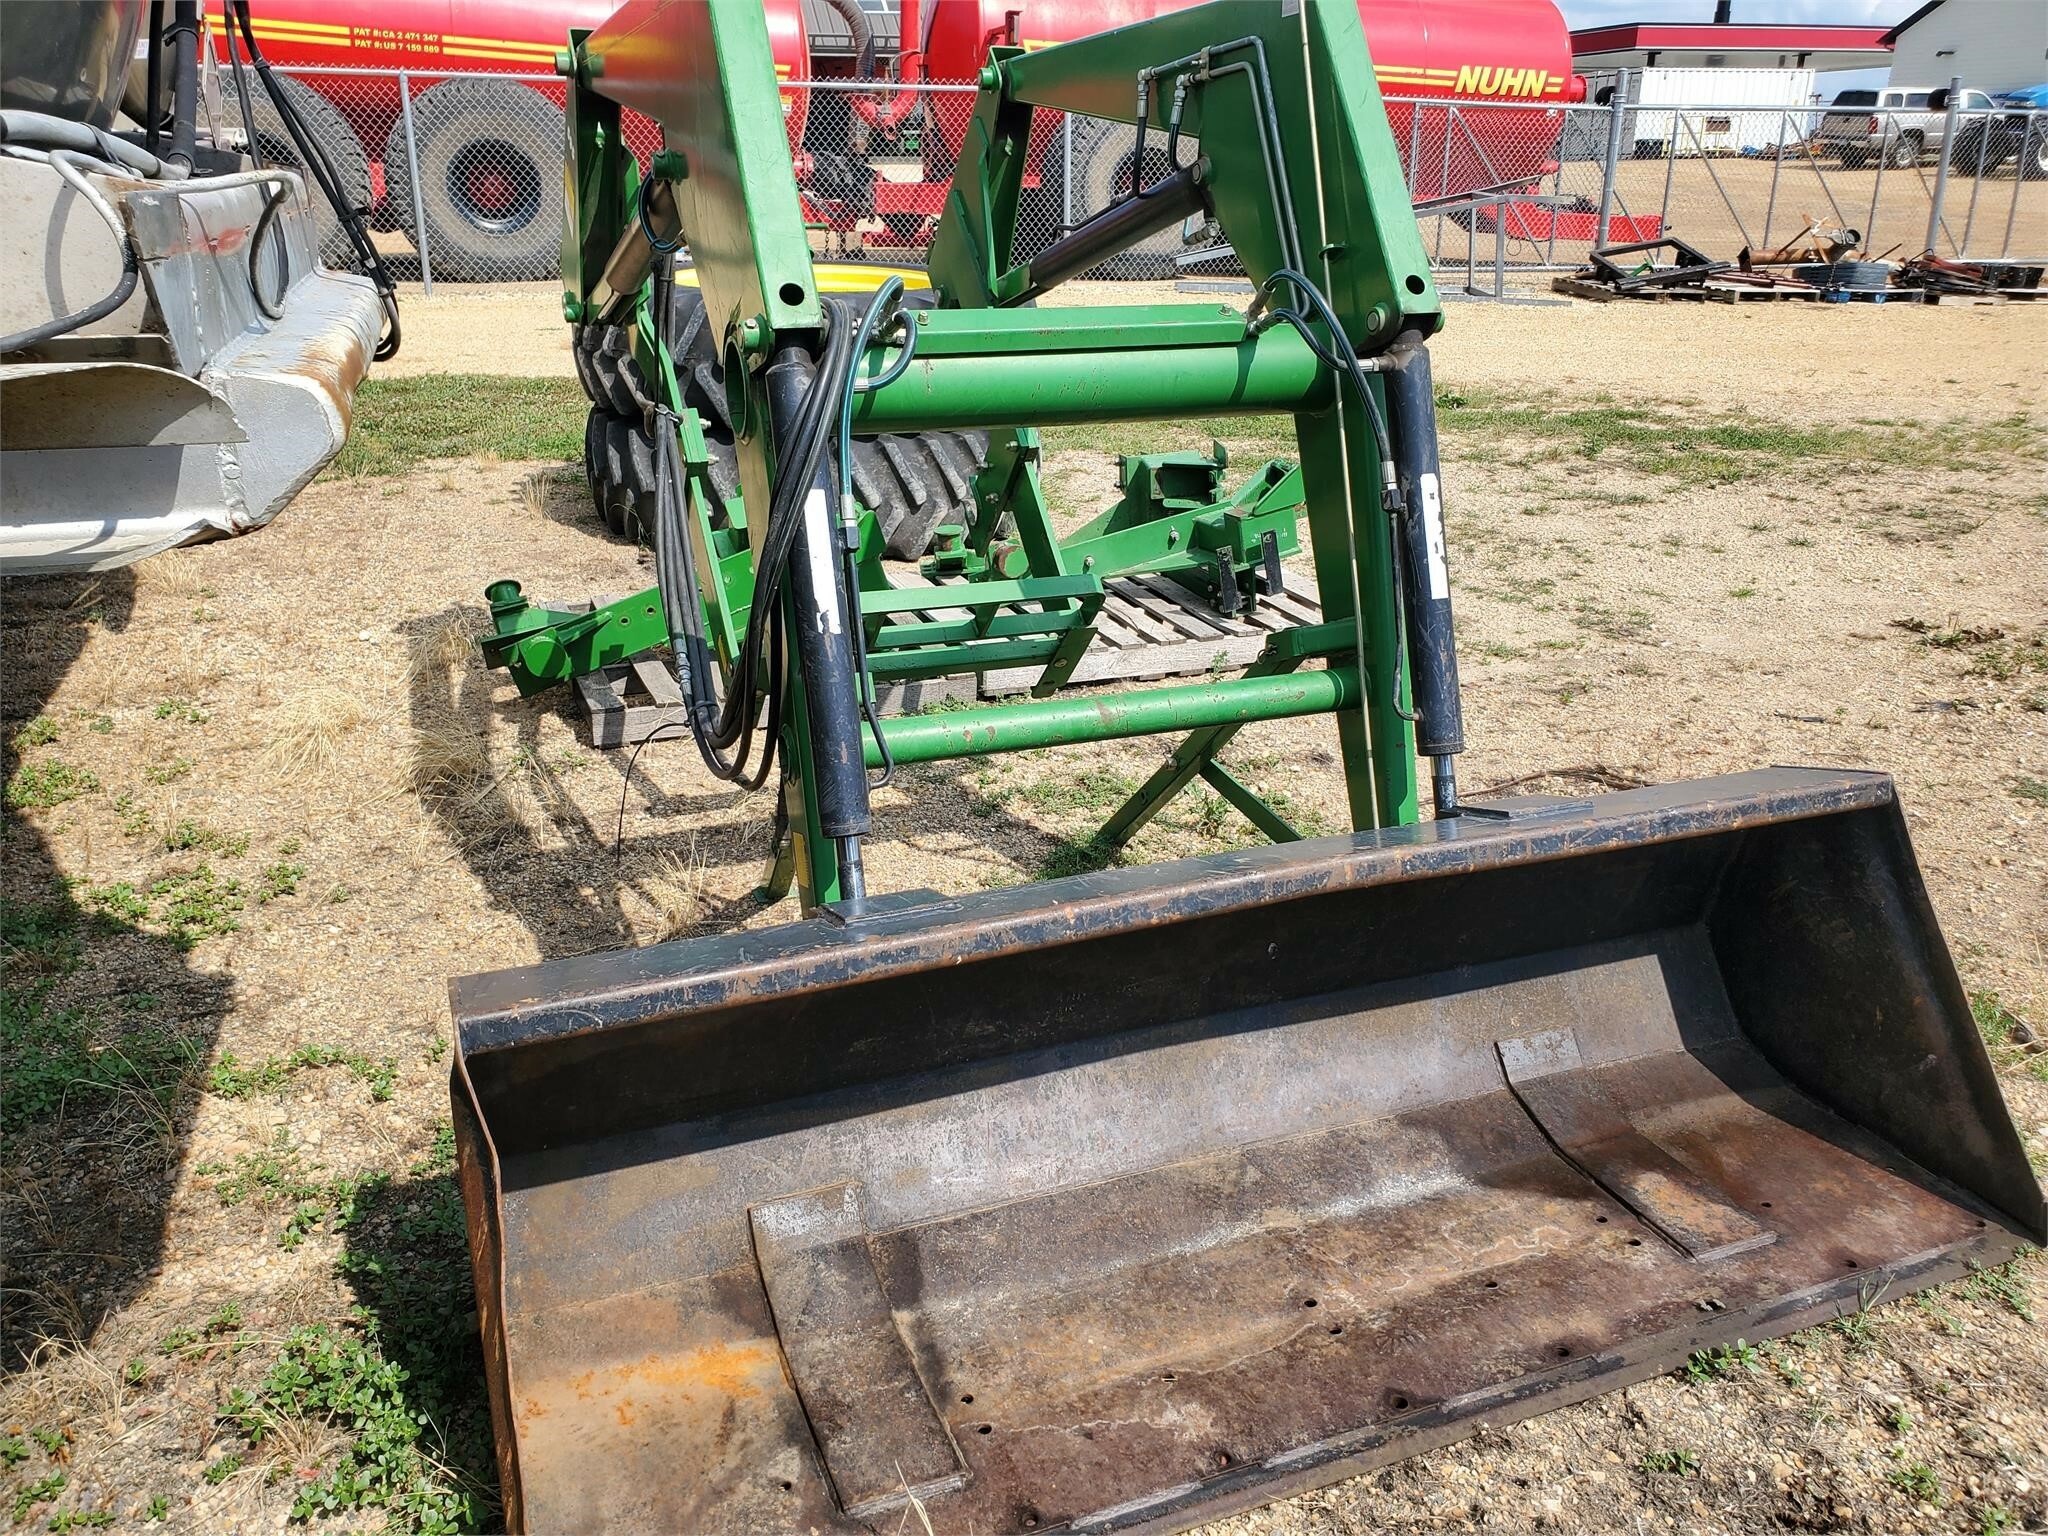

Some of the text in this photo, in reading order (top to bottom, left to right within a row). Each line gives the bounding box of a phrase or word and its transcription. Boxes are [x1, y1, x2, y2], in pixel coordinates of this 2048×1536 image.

[354, 27, 371, 36] PAT
[382, 30, 395, 40] CA
[397, 31, 403, 40] 2
[405, 32, 420, 41] 471
[423, 33, 439, 42] 347
[355, 39, 372, 48] PAT
[383, 42, 397, 51] US
[398, 42, 404, 51] 7
[406, 43, 422, 52] 159
[1455, 65, 1548, 97] NUHN
